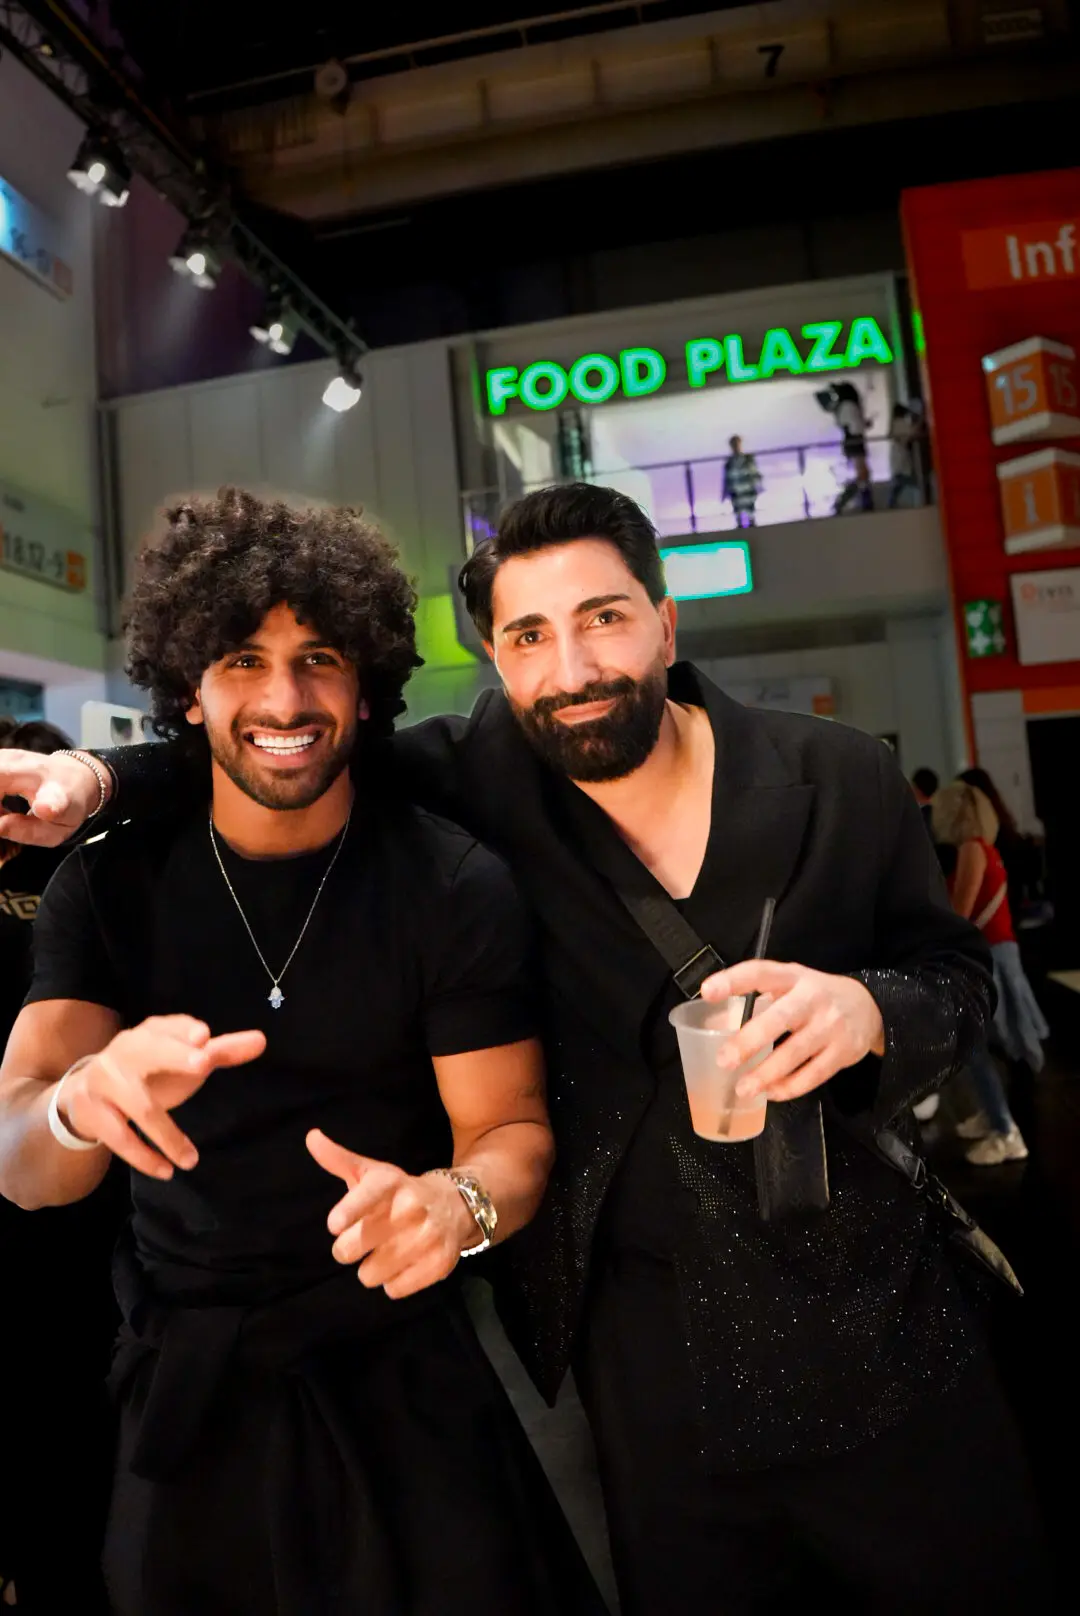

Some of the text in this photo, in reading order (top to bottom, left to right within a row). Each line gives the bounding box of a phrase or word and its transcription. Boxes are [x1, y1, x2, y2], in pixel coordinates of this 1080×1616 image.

[757, 45, 785, 78] 7
[1005, 223, 1080, 280] Inf
[485, 316, 893, 416] FOOD PLAZA
[995, 363, 1038, 416] 15
